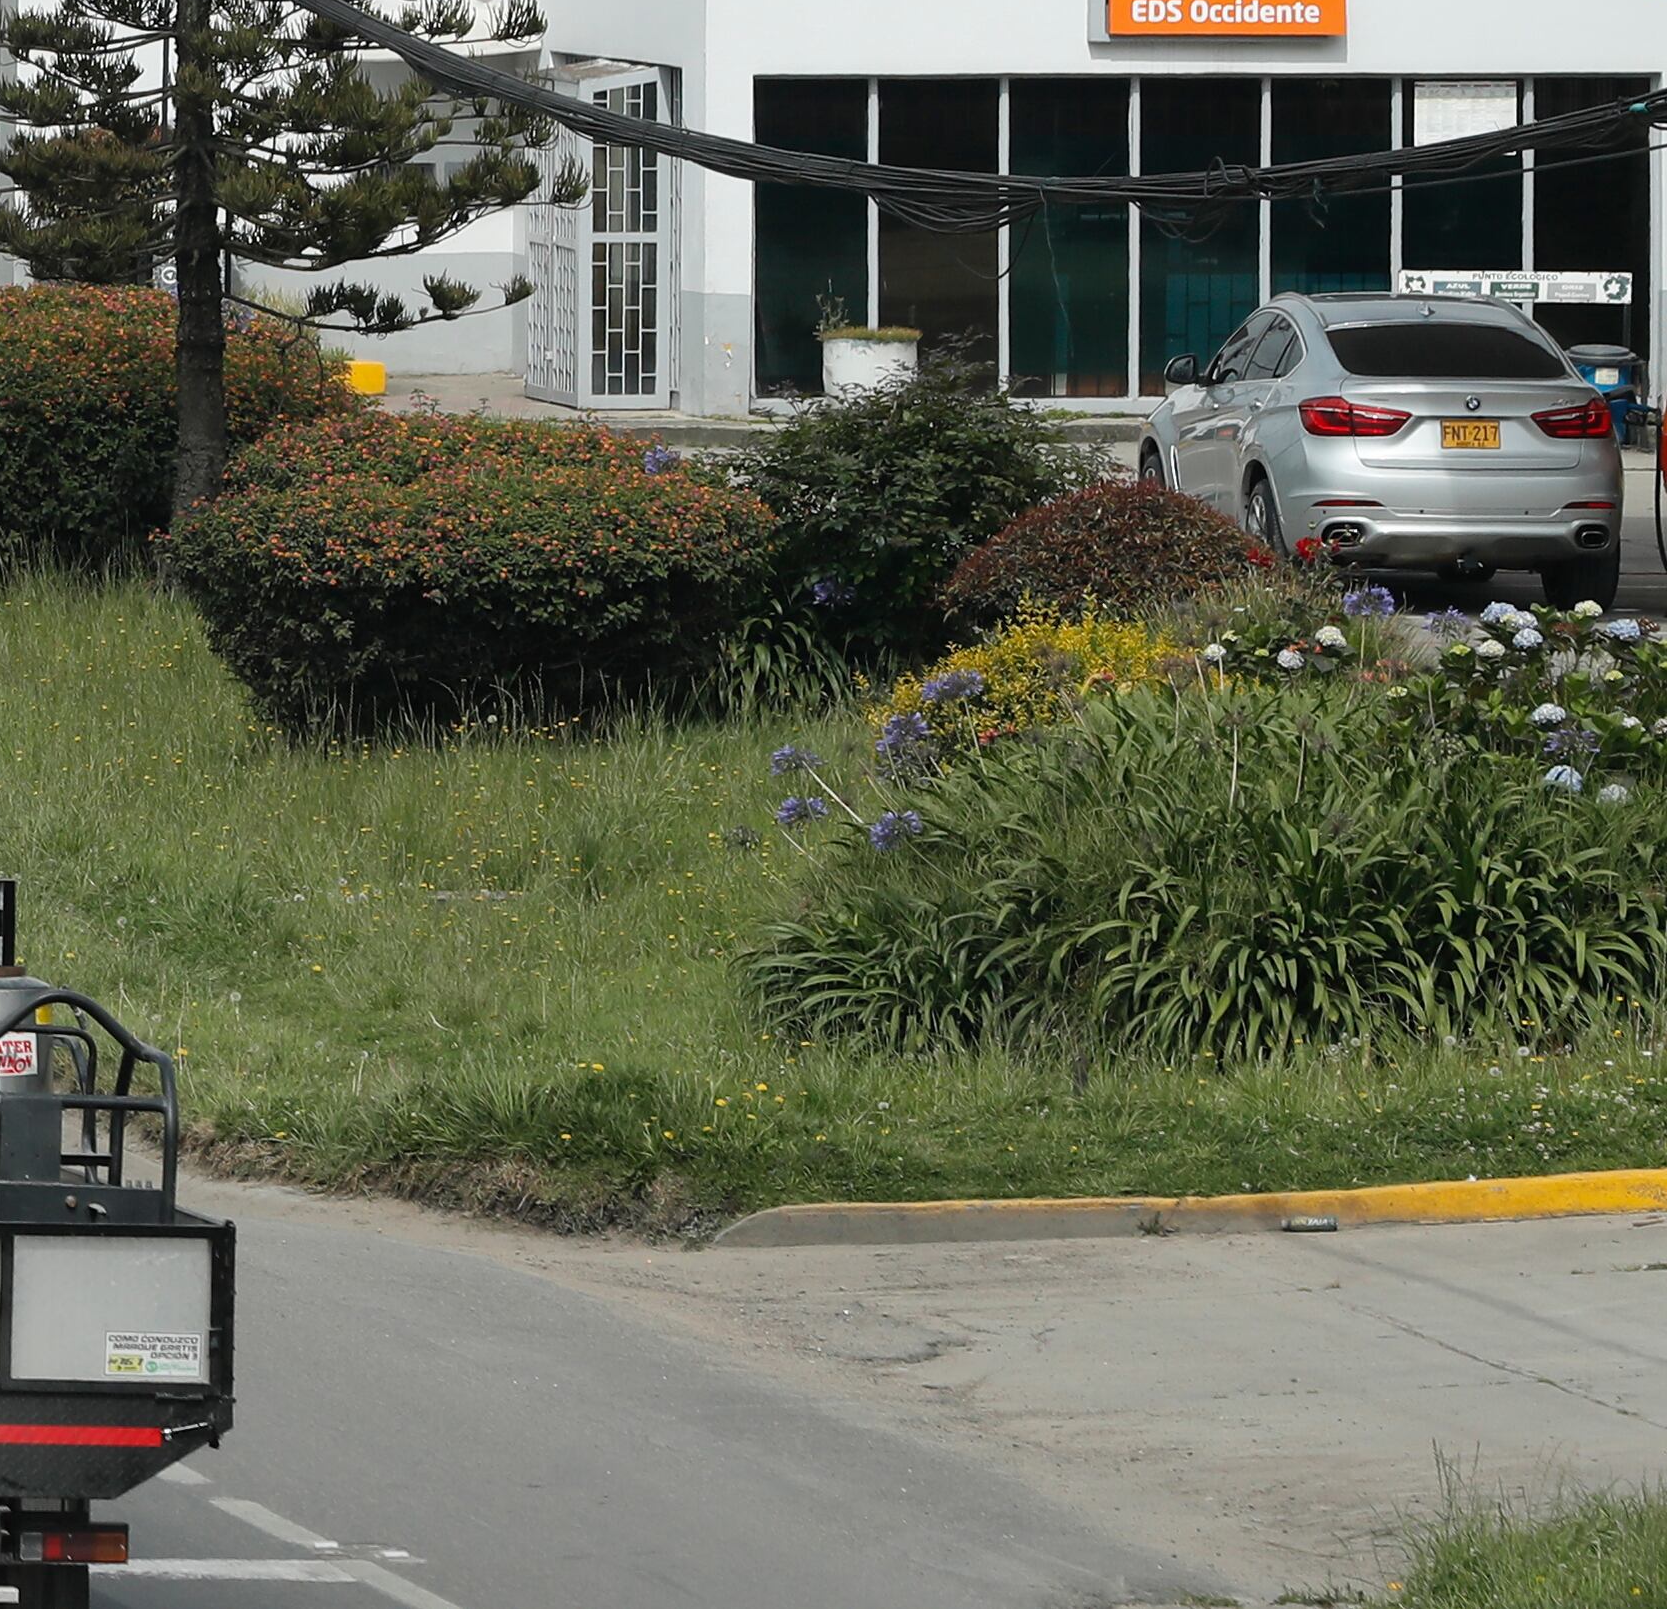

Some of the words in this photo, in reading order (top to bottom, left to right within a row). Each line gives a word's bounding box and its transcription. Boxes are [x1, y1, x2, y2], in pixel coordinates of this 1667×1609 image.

[1131, 0, 1183, 23] EDS
[1472, 272, 1503, 281] PUNTO
[108, 1334, 139, 1343] COMO
[141, 1335, 199, 1344] CONDUZCO
[113, 1343, 158, 1351] MARQUE
[160, 1344, 198, 1352] GRATIS
